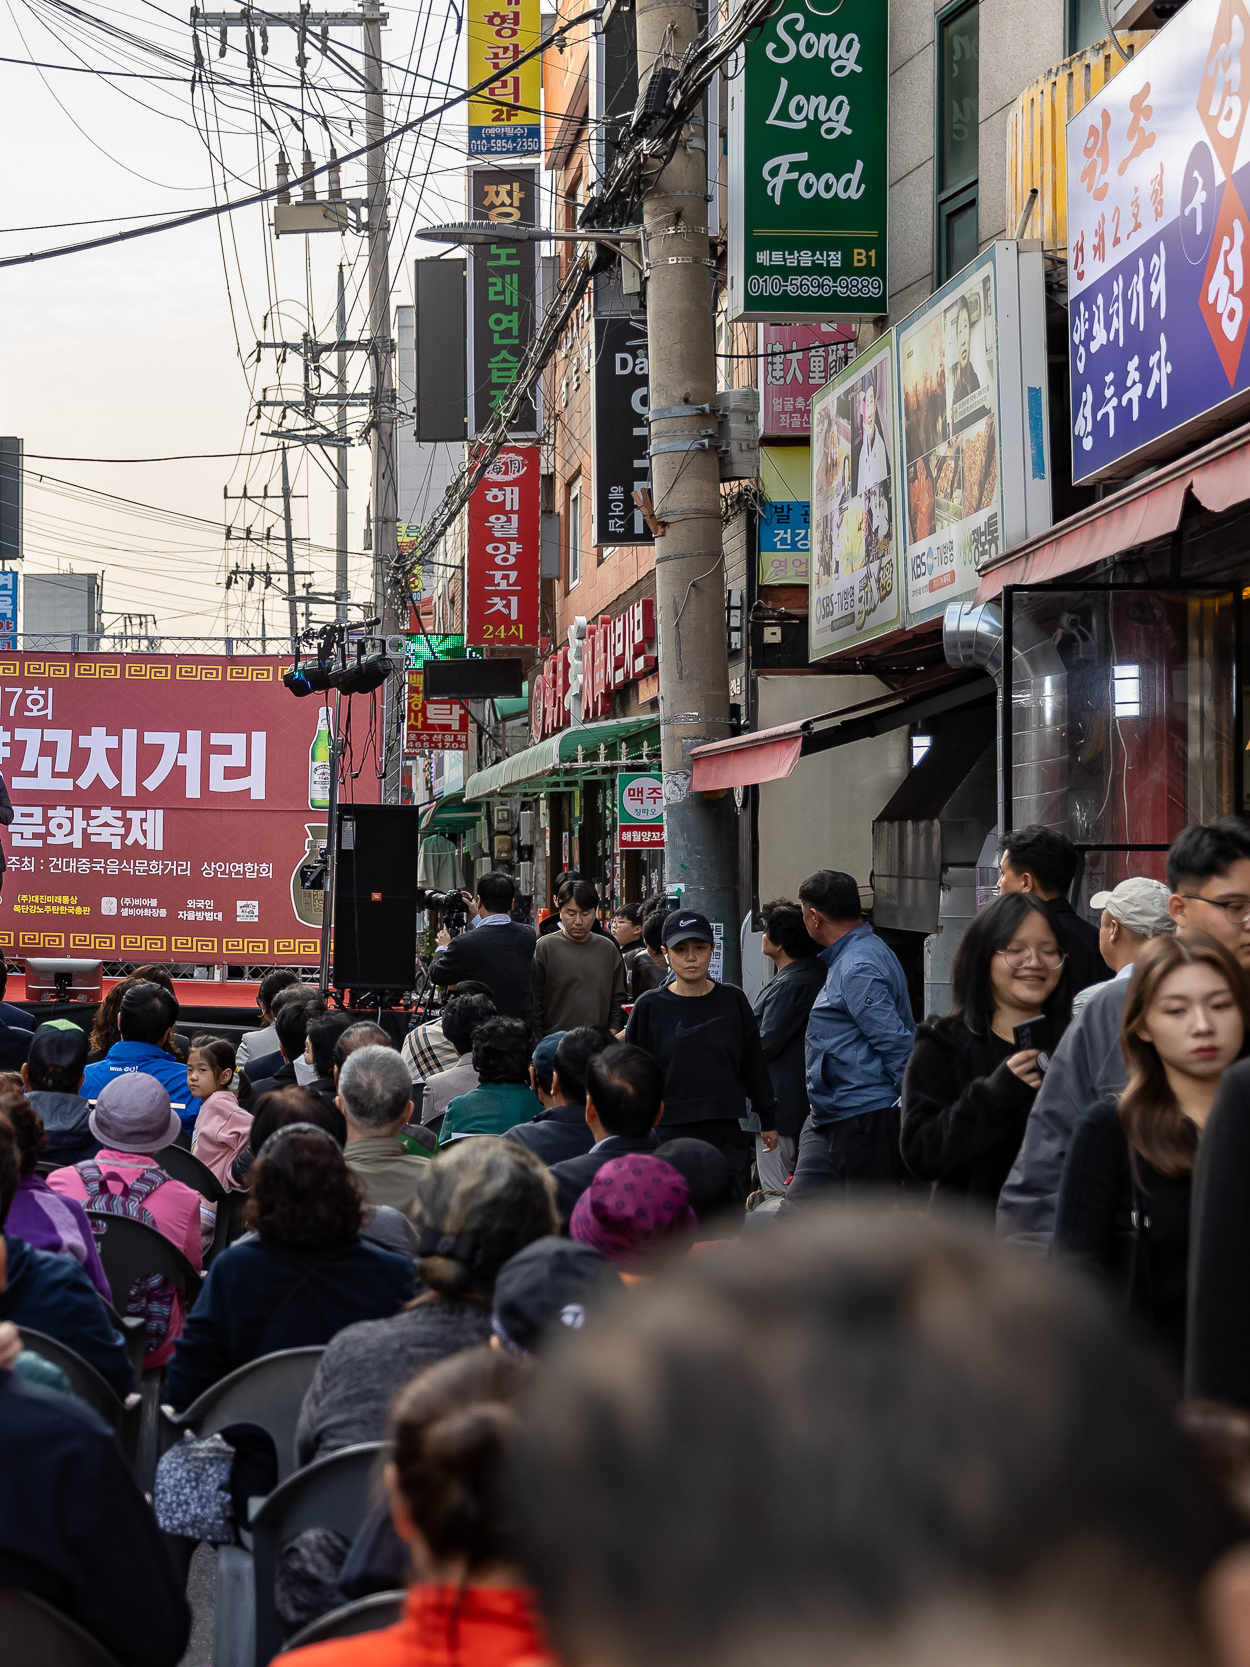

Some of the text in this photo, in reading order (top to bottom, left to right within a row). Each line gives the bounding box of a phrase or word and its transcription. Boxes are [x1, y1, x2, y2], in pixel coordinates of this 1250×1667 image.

[484, 0, 526, 104] 형관리
[765, 12, 863, 77] Song
[491, 108, 519, 122] 2F
[765, 77, 853, 139] Long
[762, 151, 866, 206] Food
[482, 182, 525, 223] 짱
[756, 249, 876, 267] 베트남음식점 B1
[748, 275, 883, 297] 010-5696-9889
[608, 485, 624, 534] 헤어샵
[483, 486, 523, 621] 해월양꼬치
[911, 551, 927, 582] KBS
[482, 624, 523, 640] 24시
[627, 786, 663, 805] 맥주
[6, 856, 274, 879] 주최 건대중국음식문화거리 상인연합회
[177, 910, 224, 923] 자율방범대
[186, 899, 215, 910] 외국인
